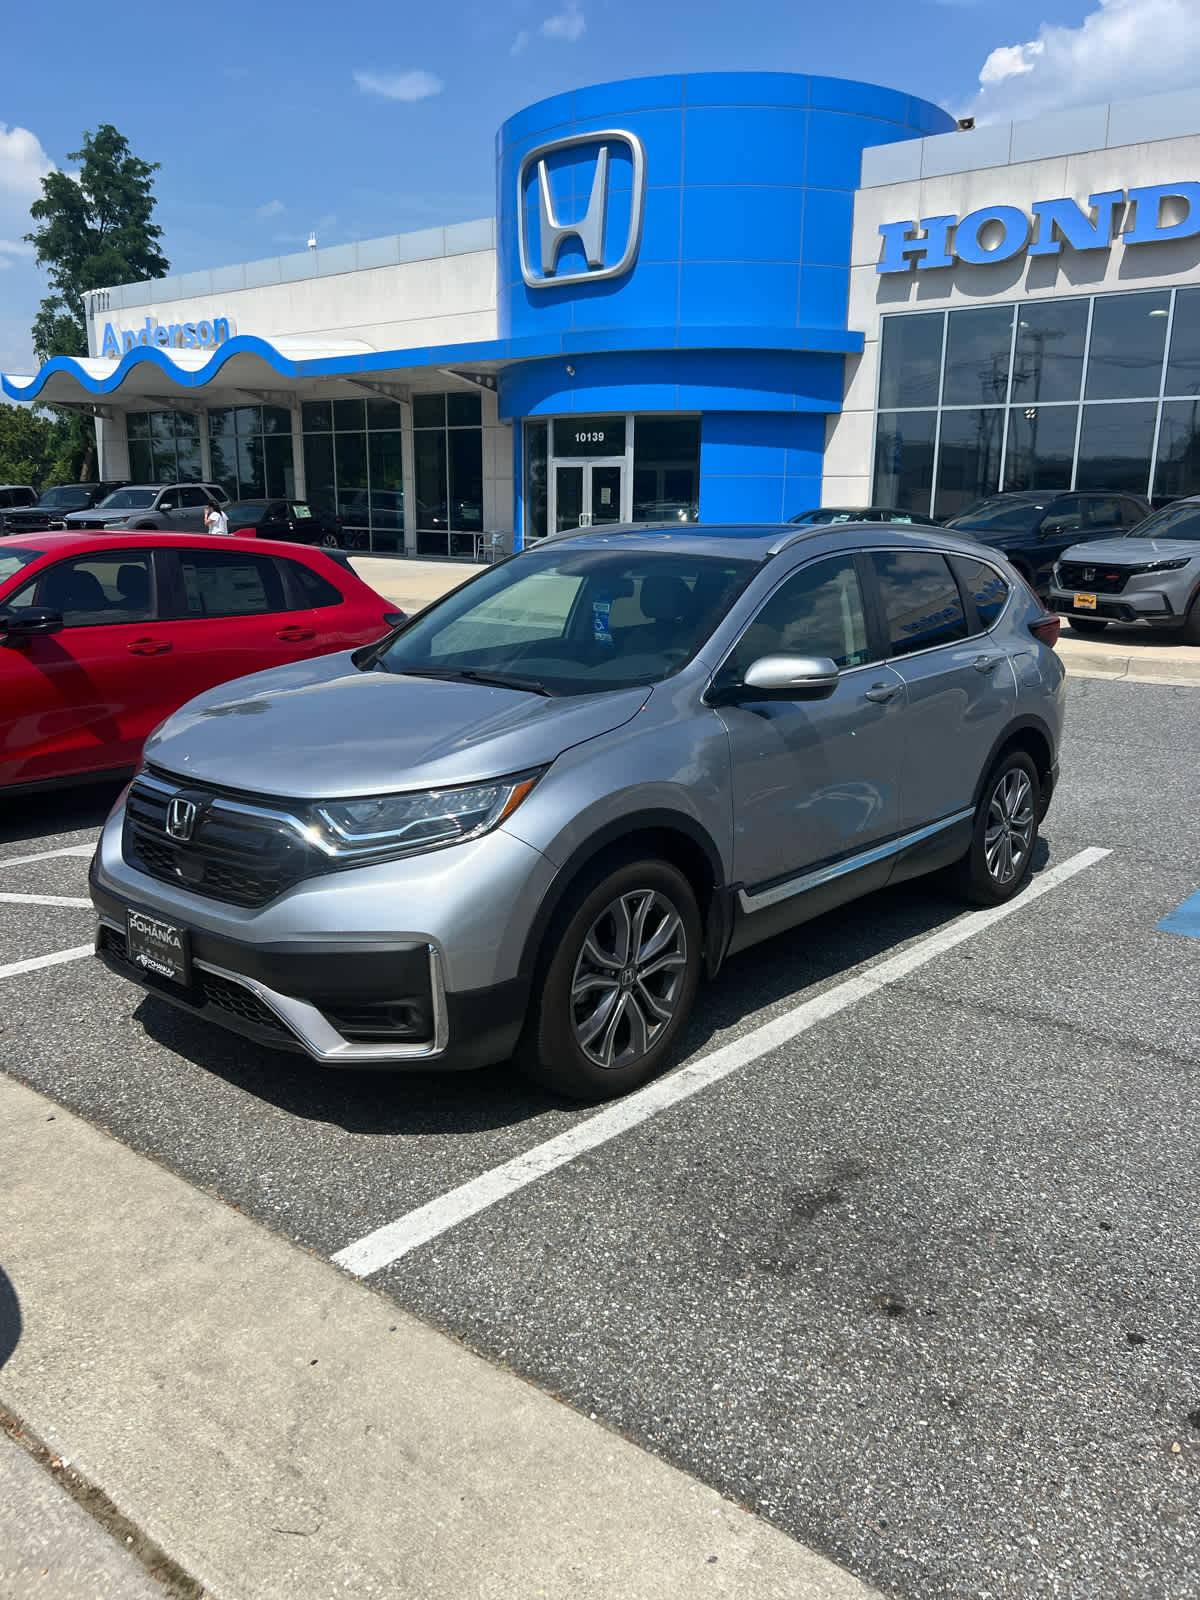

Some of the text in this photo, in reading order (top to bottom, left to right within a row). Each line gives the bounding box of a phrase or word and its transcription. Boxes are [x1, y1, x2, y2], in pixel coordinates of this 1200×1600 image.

[102, 314, 231, 357] Anderson
[575, 432, 605, 443] 10139
[129, 917, 182, 949] POHANKA
